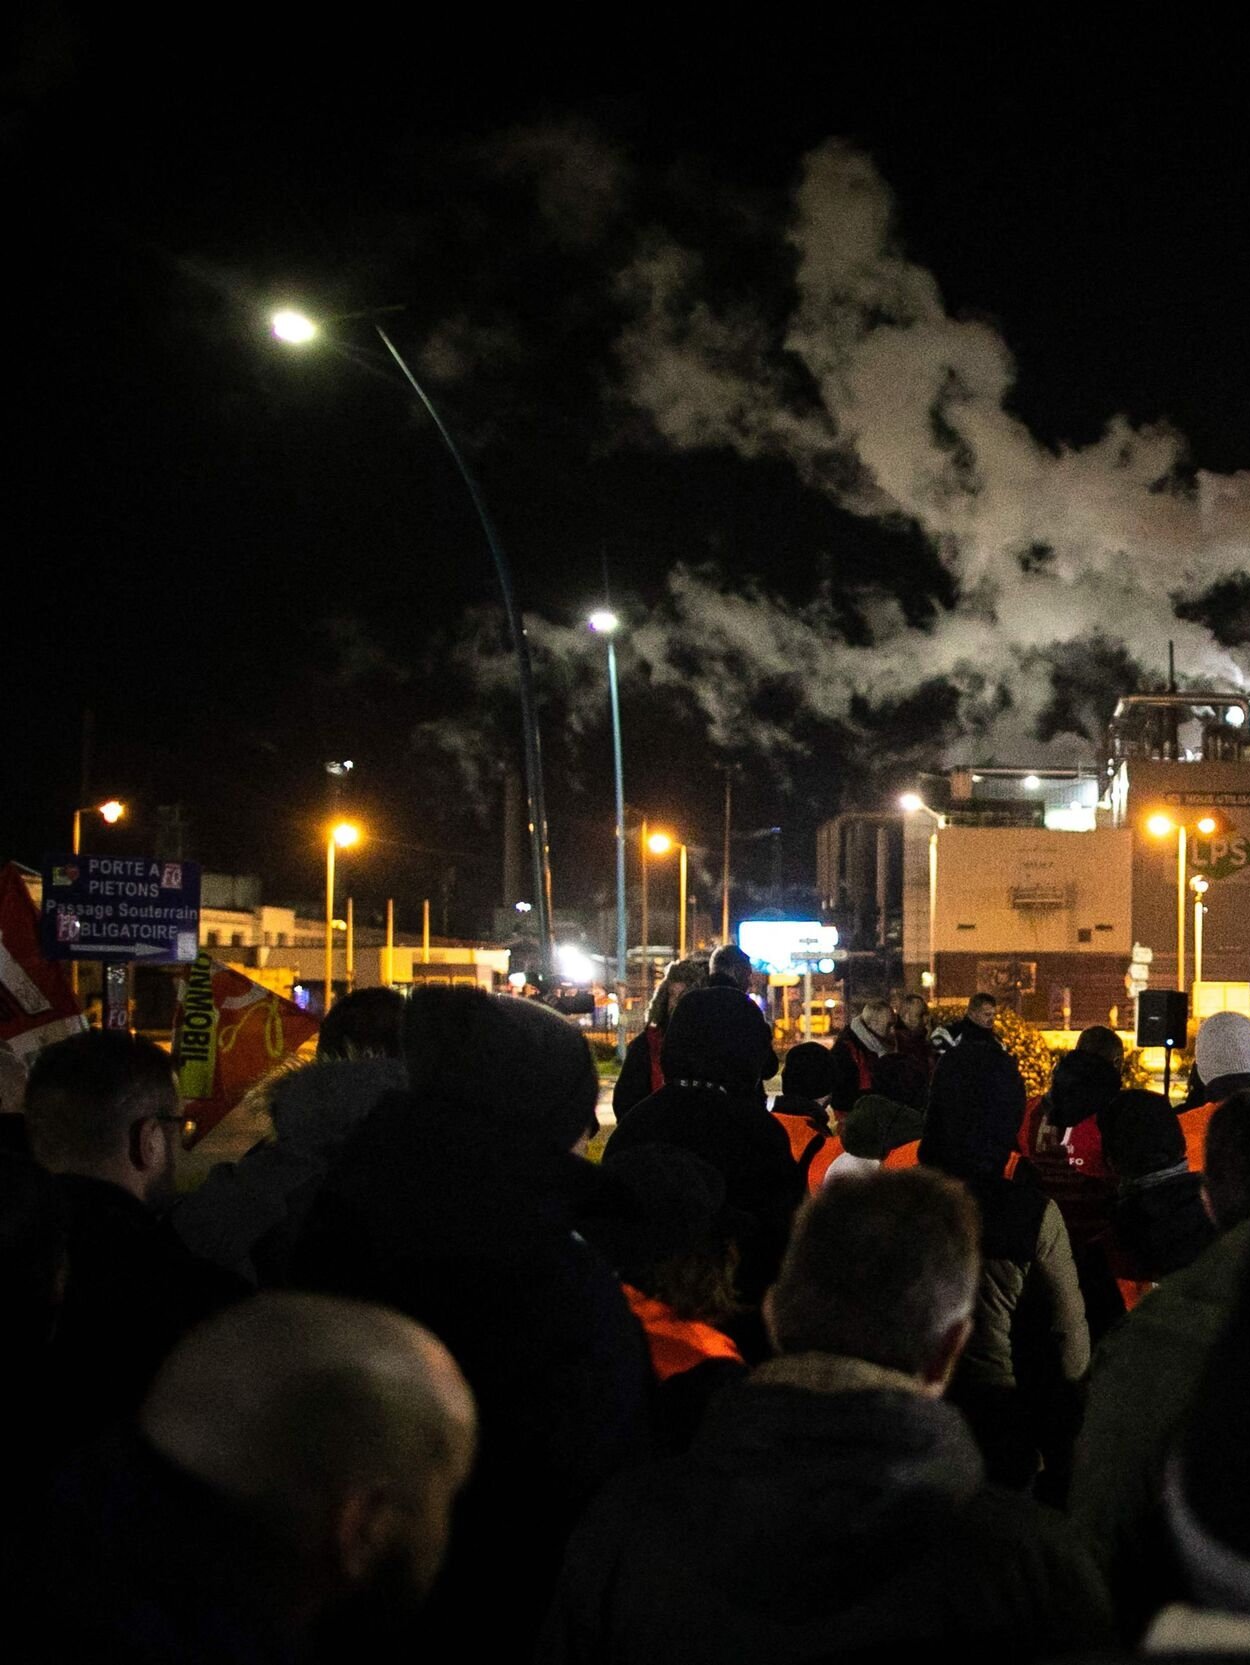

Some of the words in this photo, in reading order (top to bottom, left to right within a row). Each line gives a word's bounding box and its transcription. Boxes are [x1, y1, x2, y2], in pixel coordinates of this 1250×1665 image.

[1191, 837, 1248, 866] LPS
[88, 859, 145, 876] PORTE
[150, 863, 160, 877] A
[89, 880, 160, 898] PIETONS
[45, 899, 113, 920] Passage
[119, 902, 198, 920] Souterrain
[80, 922, 178, 939] BLIGATOIRE
[109, 1010, 127, 1026] FO
